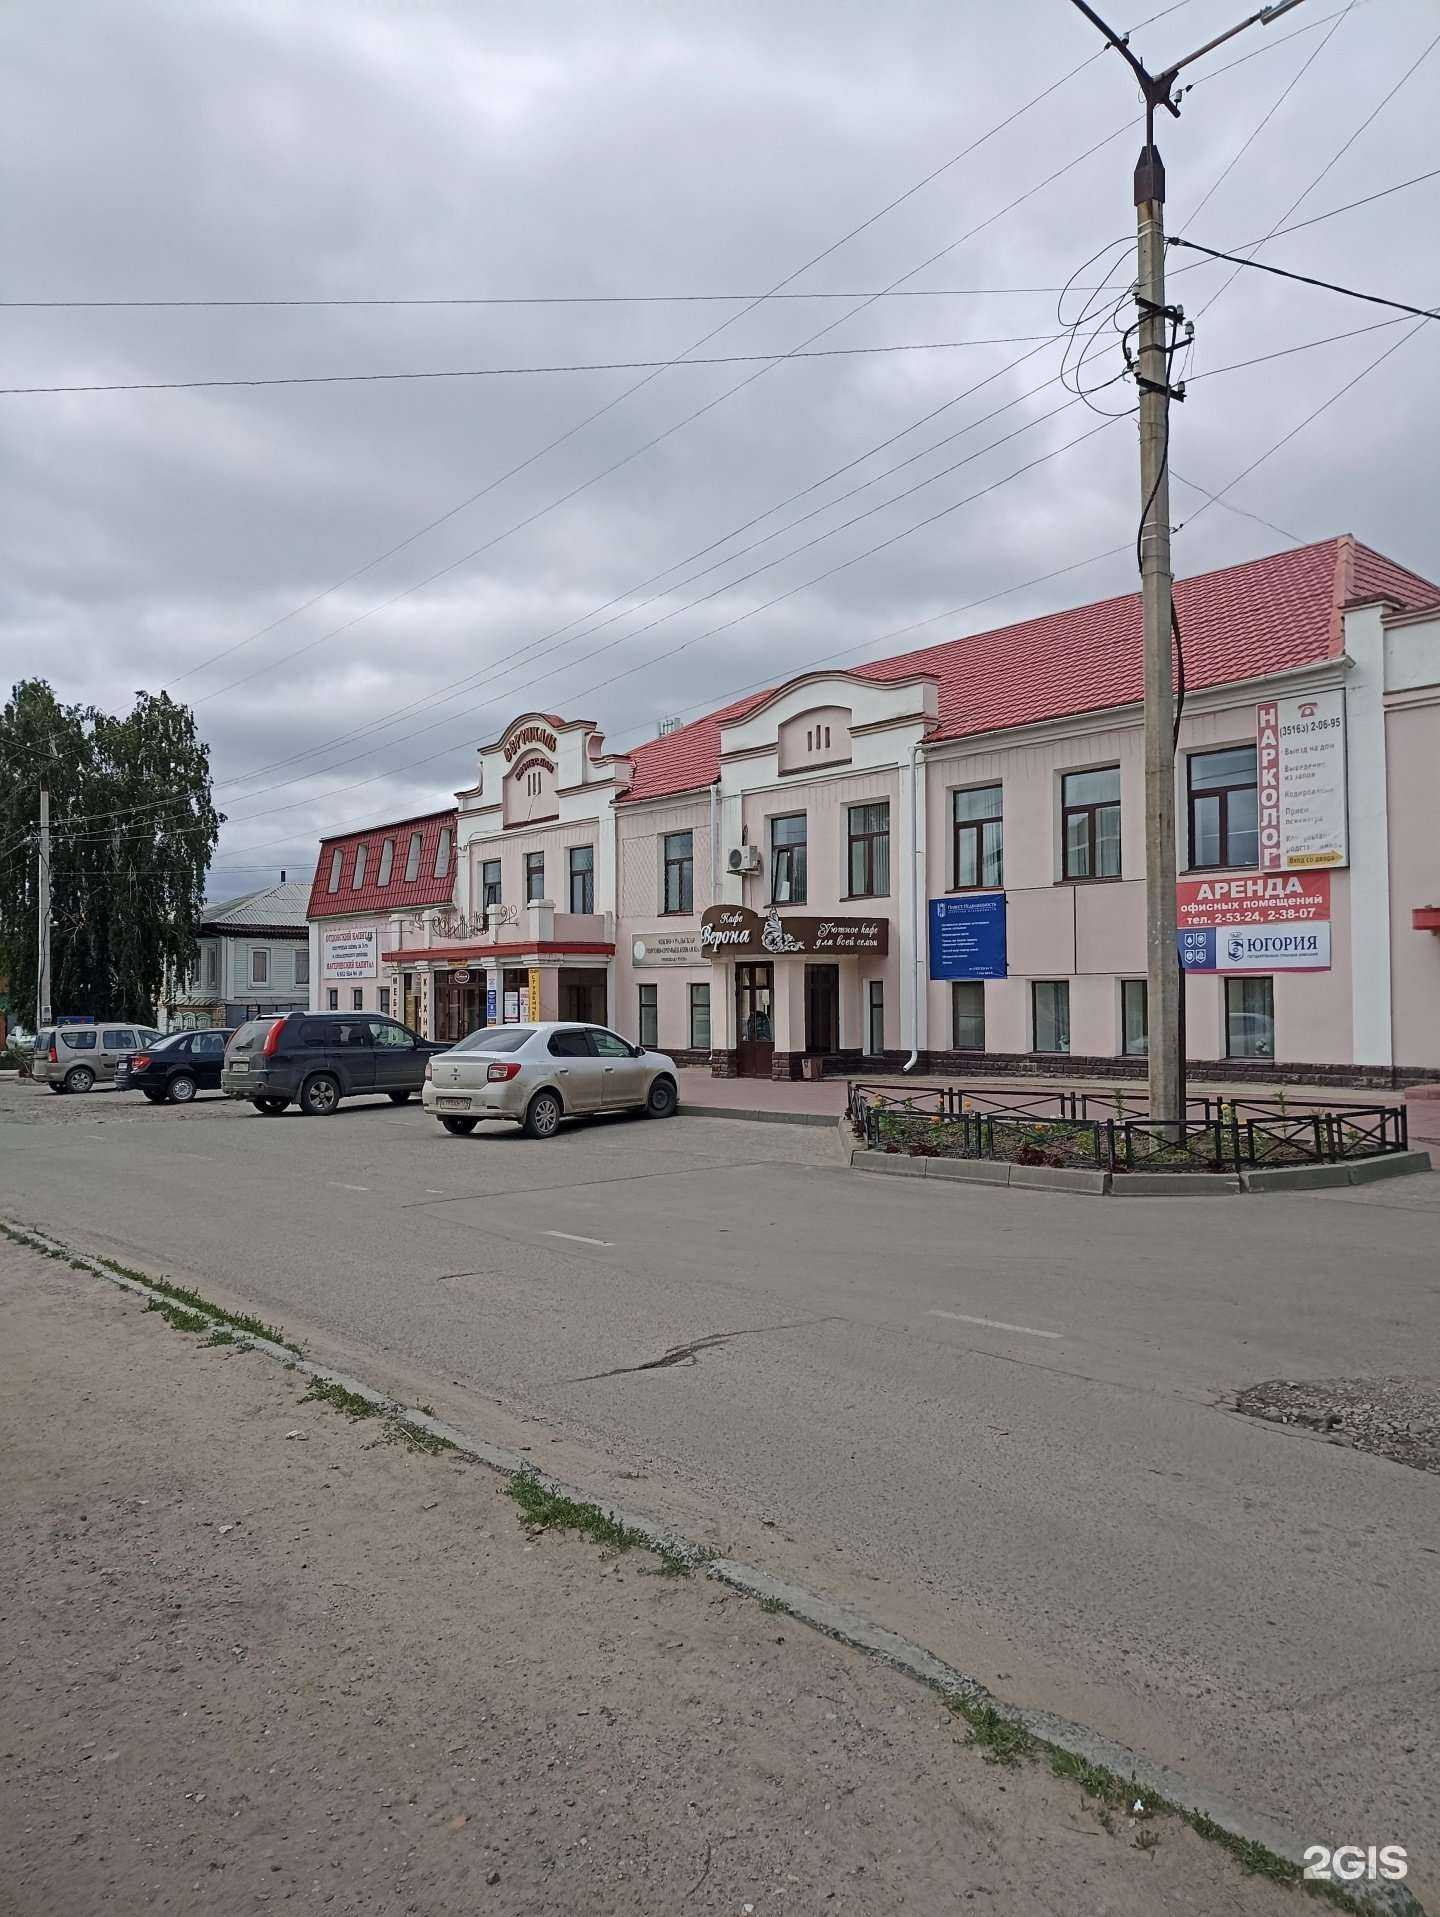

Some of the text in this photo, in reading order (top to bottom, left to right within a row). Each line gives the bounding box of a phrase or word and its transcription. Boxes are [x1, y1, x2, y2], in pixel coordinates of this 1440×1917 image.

[1280, 717, 1341, 737] (35163) 2-06-95
[1259, 707, 1280, 866] НАРКОЛОГ
[1197, 876, 1303, 900] АРЕНДА
[1181, 894, 1323, 913] офисных помещений
[719, 911, 743, 927] Кафе
[1187, 915, 1211, 925] тел.
[1268, 907, 1316, 920] 2-38-07
[701, 923, 751, 952] Верона
[817, 922, 878, 938] Уютное кафе
[812, 935, 878, 950] для всей семьи
[1247, 935, 1318, 952] ЮГОРИЯ
